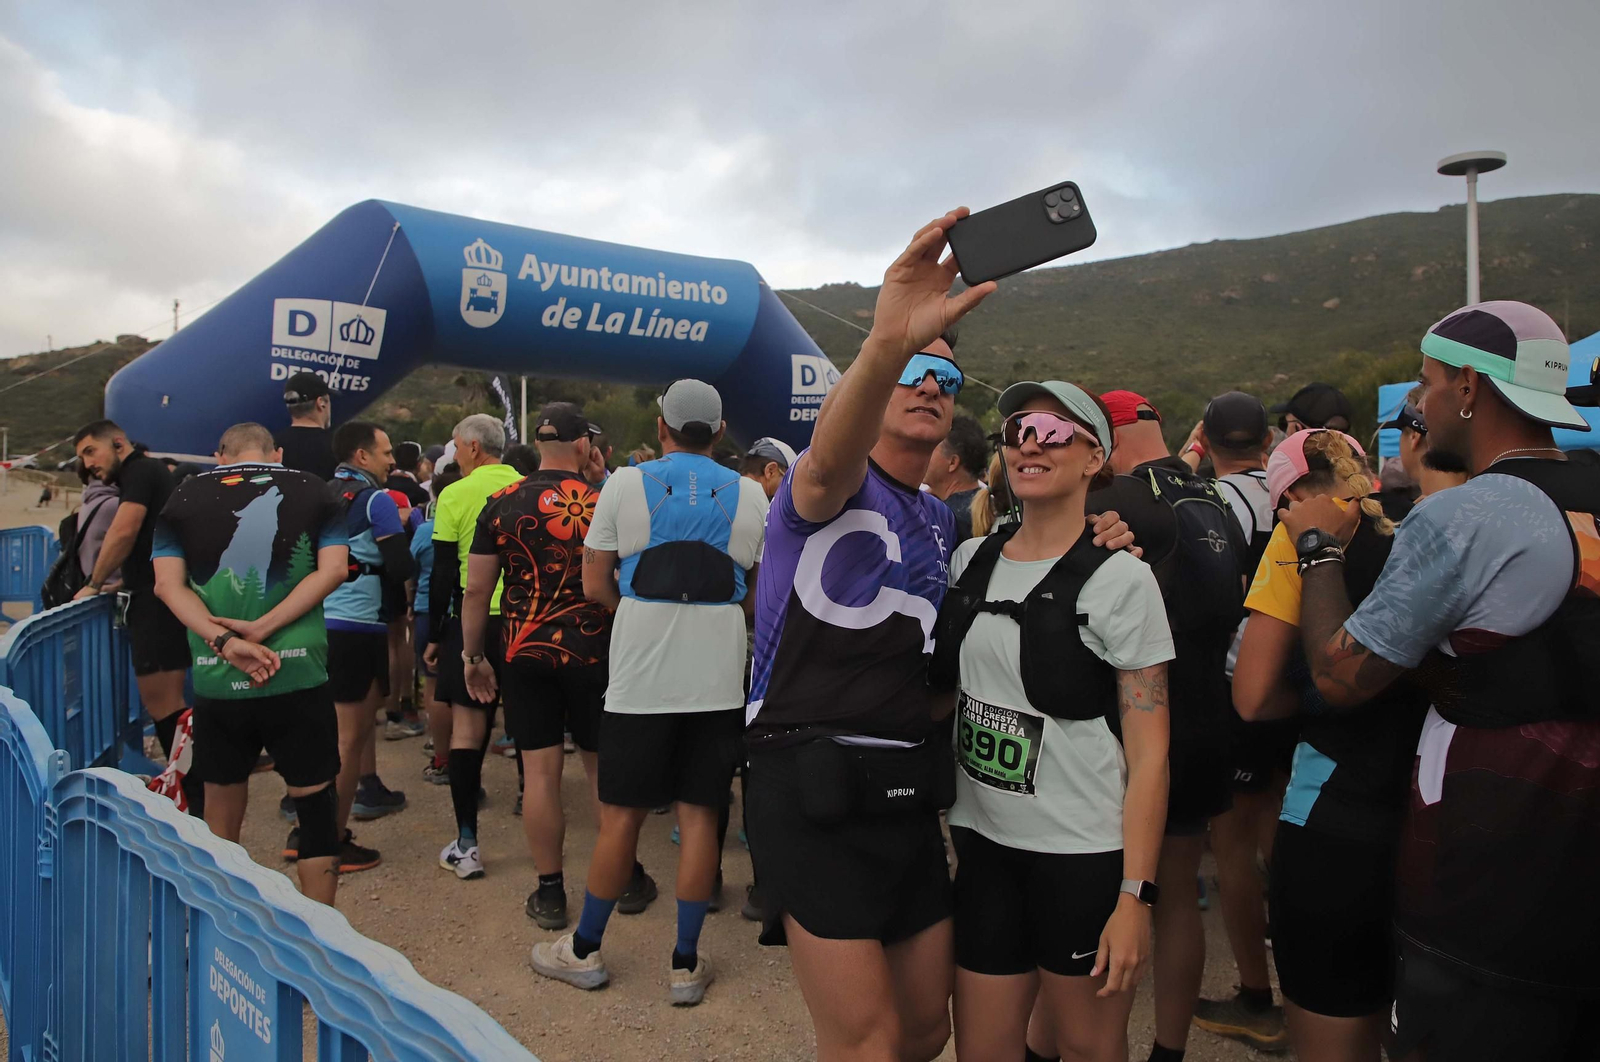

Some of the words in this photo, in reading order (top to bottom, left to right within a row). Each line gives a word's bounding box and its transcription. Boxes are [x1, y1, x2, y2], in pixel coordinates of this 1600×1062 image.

[517, 253, 728, 305] Ayuntamiento
[287, 309, 317, 337] D
[541, 297, 582, 329] de
[586, 303, 625, 334] La
[628, 308, 709, 342] Línea
[271, 347, 345, 367] DELEGACIÓN
[346, 358, 361, 369] DE
[801, 364, 817, 387] D
[789, 408, 820, 422] DEP
[790, 396, 825, 405] DELEGAC
[689, 470, 697, 505] EVADICT
[963, 706, 1026, 737] CARBONERA
[966, 696, 984, 716] XIII
[984, 705, 1019, 719] EDICIÓN
[984, 711, 1018, 726] CRESTA
[962, 721, 1023, 771] 390
[214, 946, 255, 995] DELEGACIÓN
[255, 984, 266, 1005] DE
[210, 964, 271, 1044] DEPORTES
